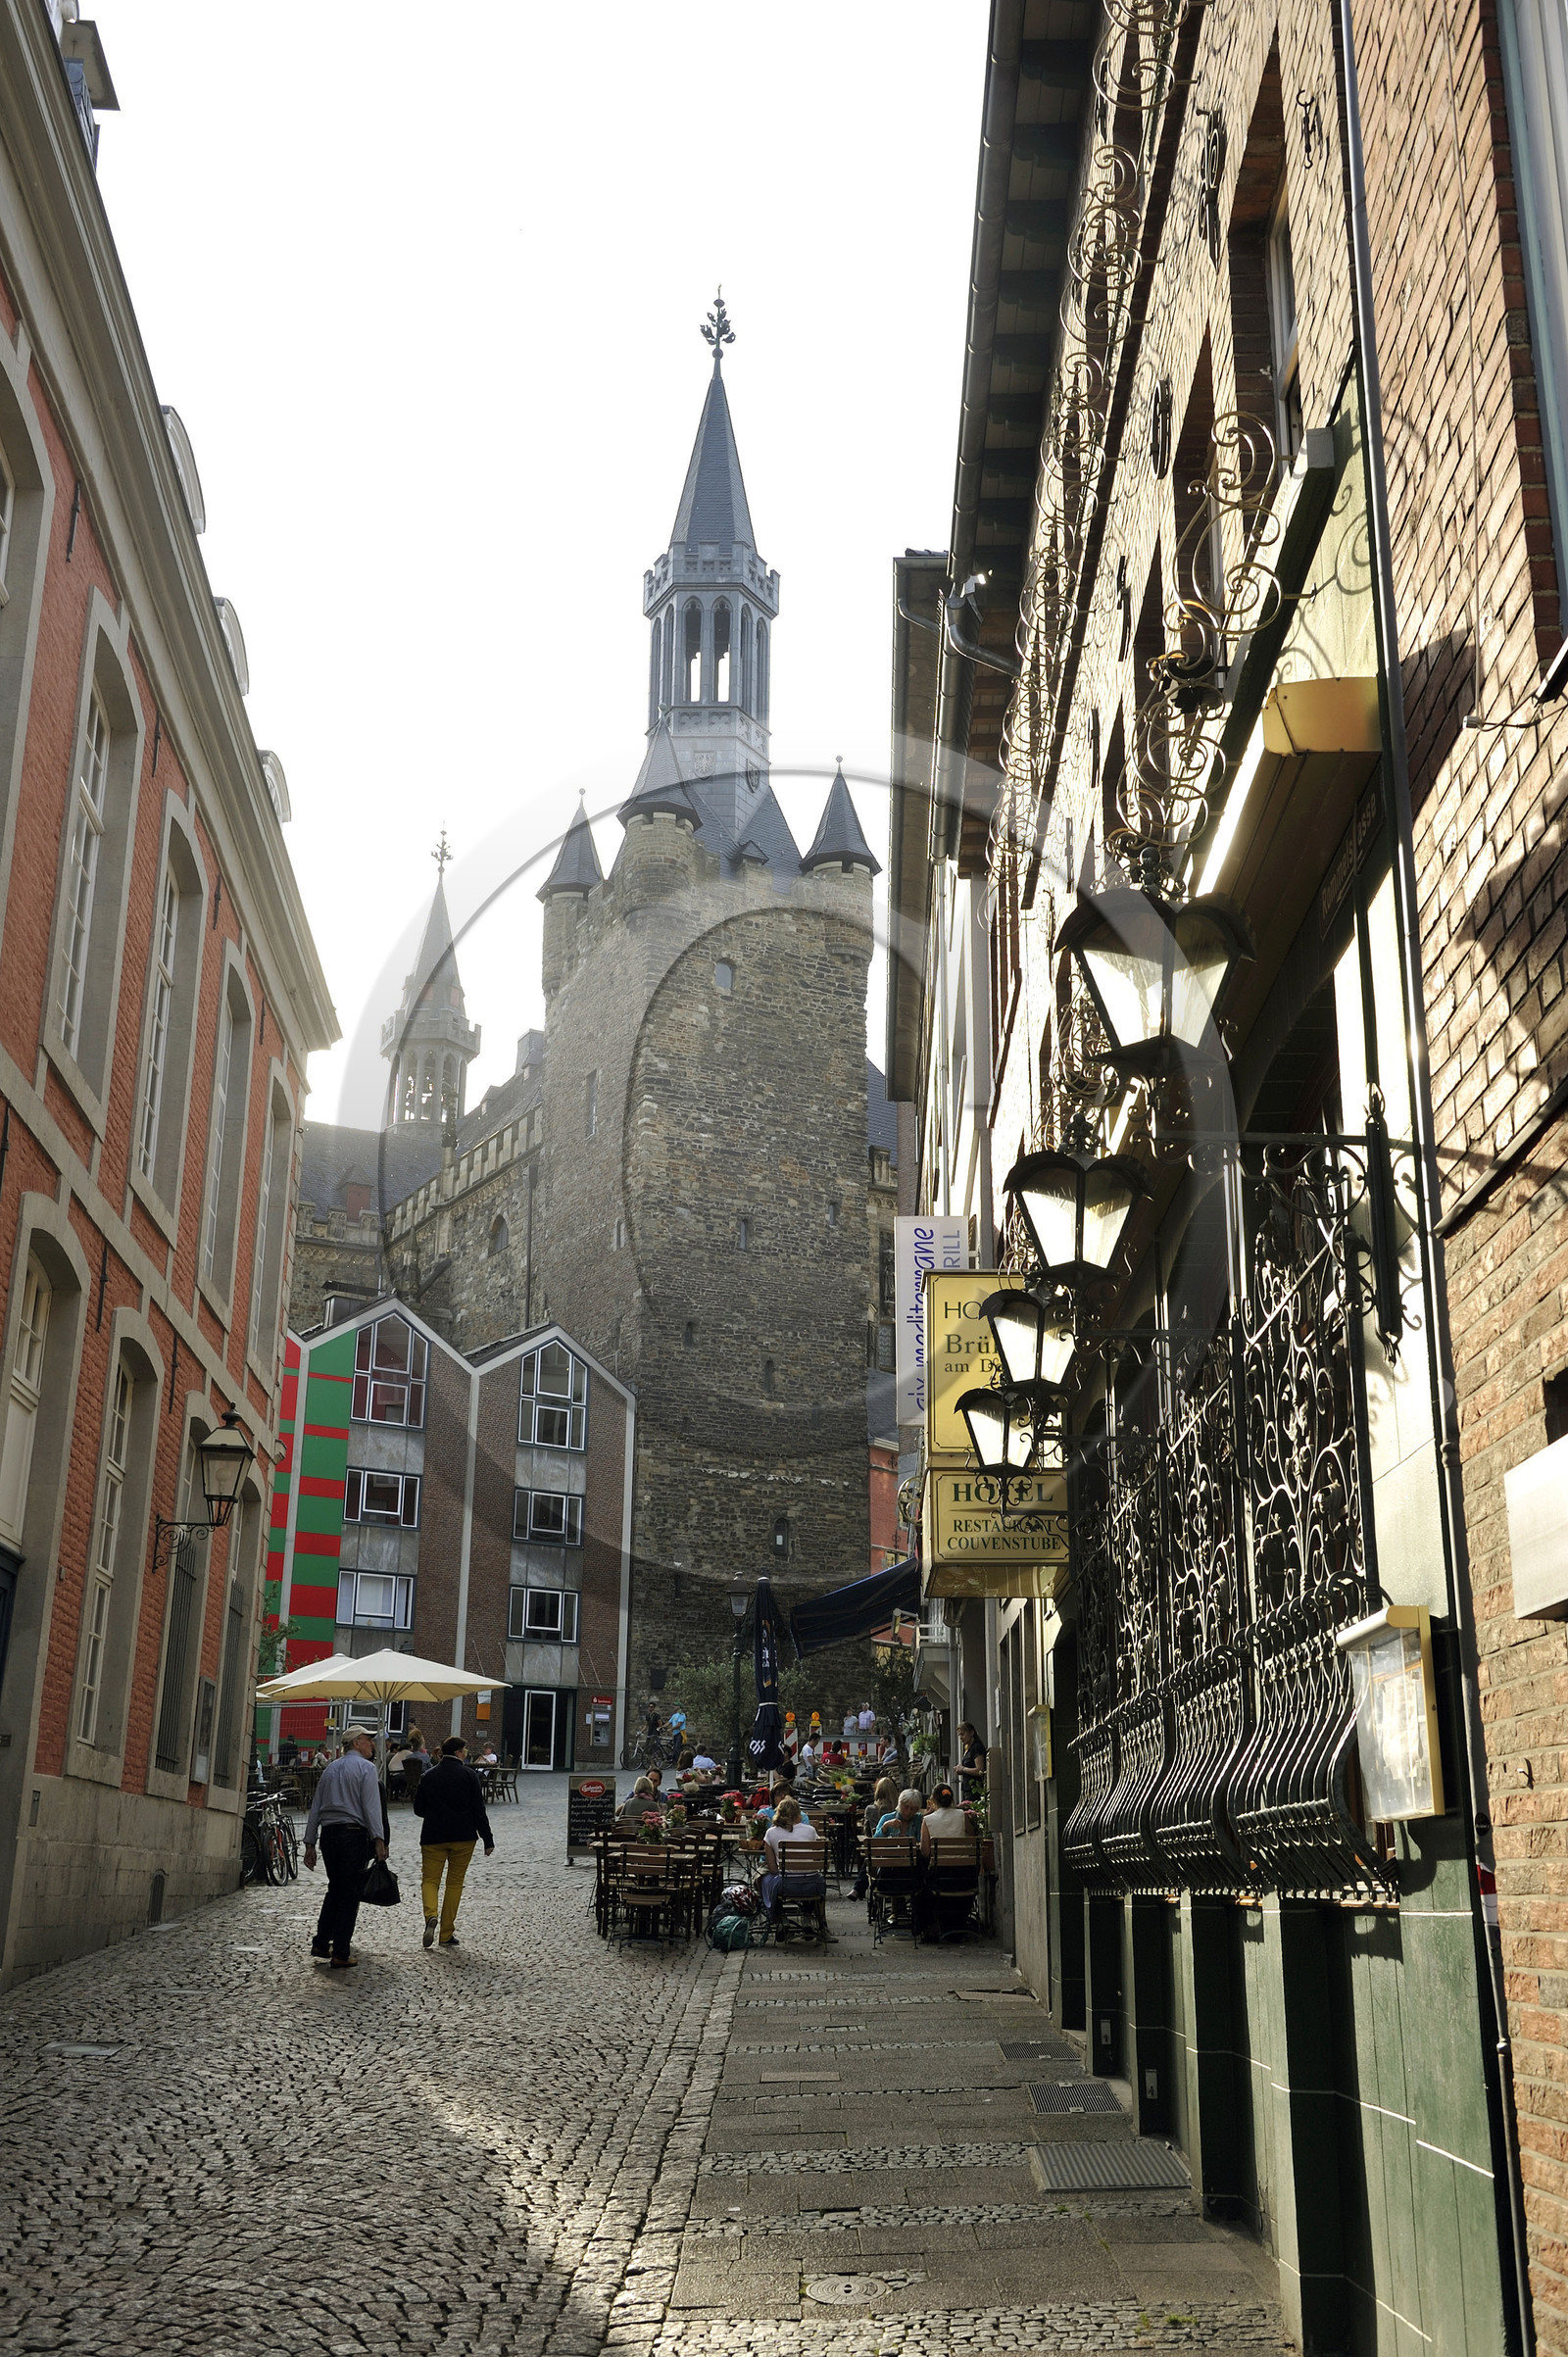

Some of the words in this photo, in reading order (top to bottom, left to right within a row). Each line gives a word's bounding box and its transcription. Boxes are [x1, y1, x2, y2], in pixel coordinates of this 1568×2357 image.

[1320, 792, 1377, 919] Rommelsasse
[943, 1230, 960, 1268] RILL
[945, 1301, 982, 1320] HO
[944, 1362, 970, 1373] am
[953, 1483, 1054, 1502] HOEL
[947, 1537, 1061, 1550] COUVENSTUBE
